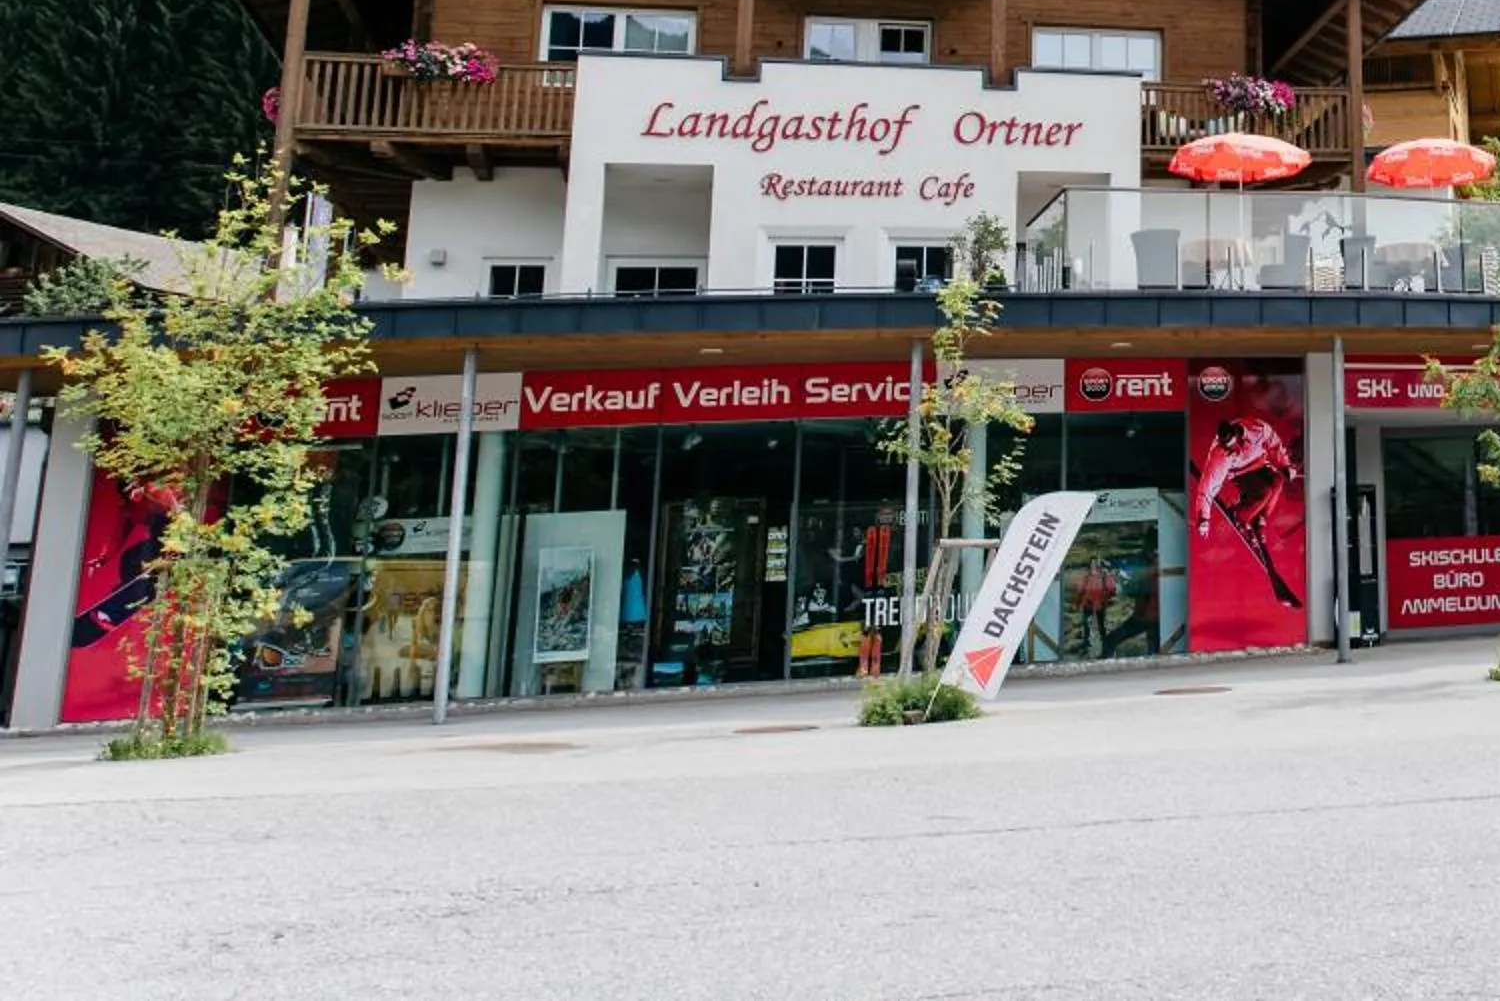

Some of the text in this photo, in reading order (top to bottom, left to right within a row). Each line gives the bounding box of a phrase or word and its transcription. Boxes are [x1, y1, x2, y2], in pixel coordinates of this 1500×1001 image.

[640, 99, 1083, 156] Landgasthof Ortner
[760, 172, 976, 205] Restaurant Cafe
[524, 375, 931, 414] Verkauf Verleih Servic
[1115, 371, 1173, 398] rent
[1357, 378, 1400, 398] SKI-
[1407, 383, 1445, 398] UND
[983, 511, 1061, 638] DACHSTEIN
[1433, 570, 1485, 590] BÜRO
